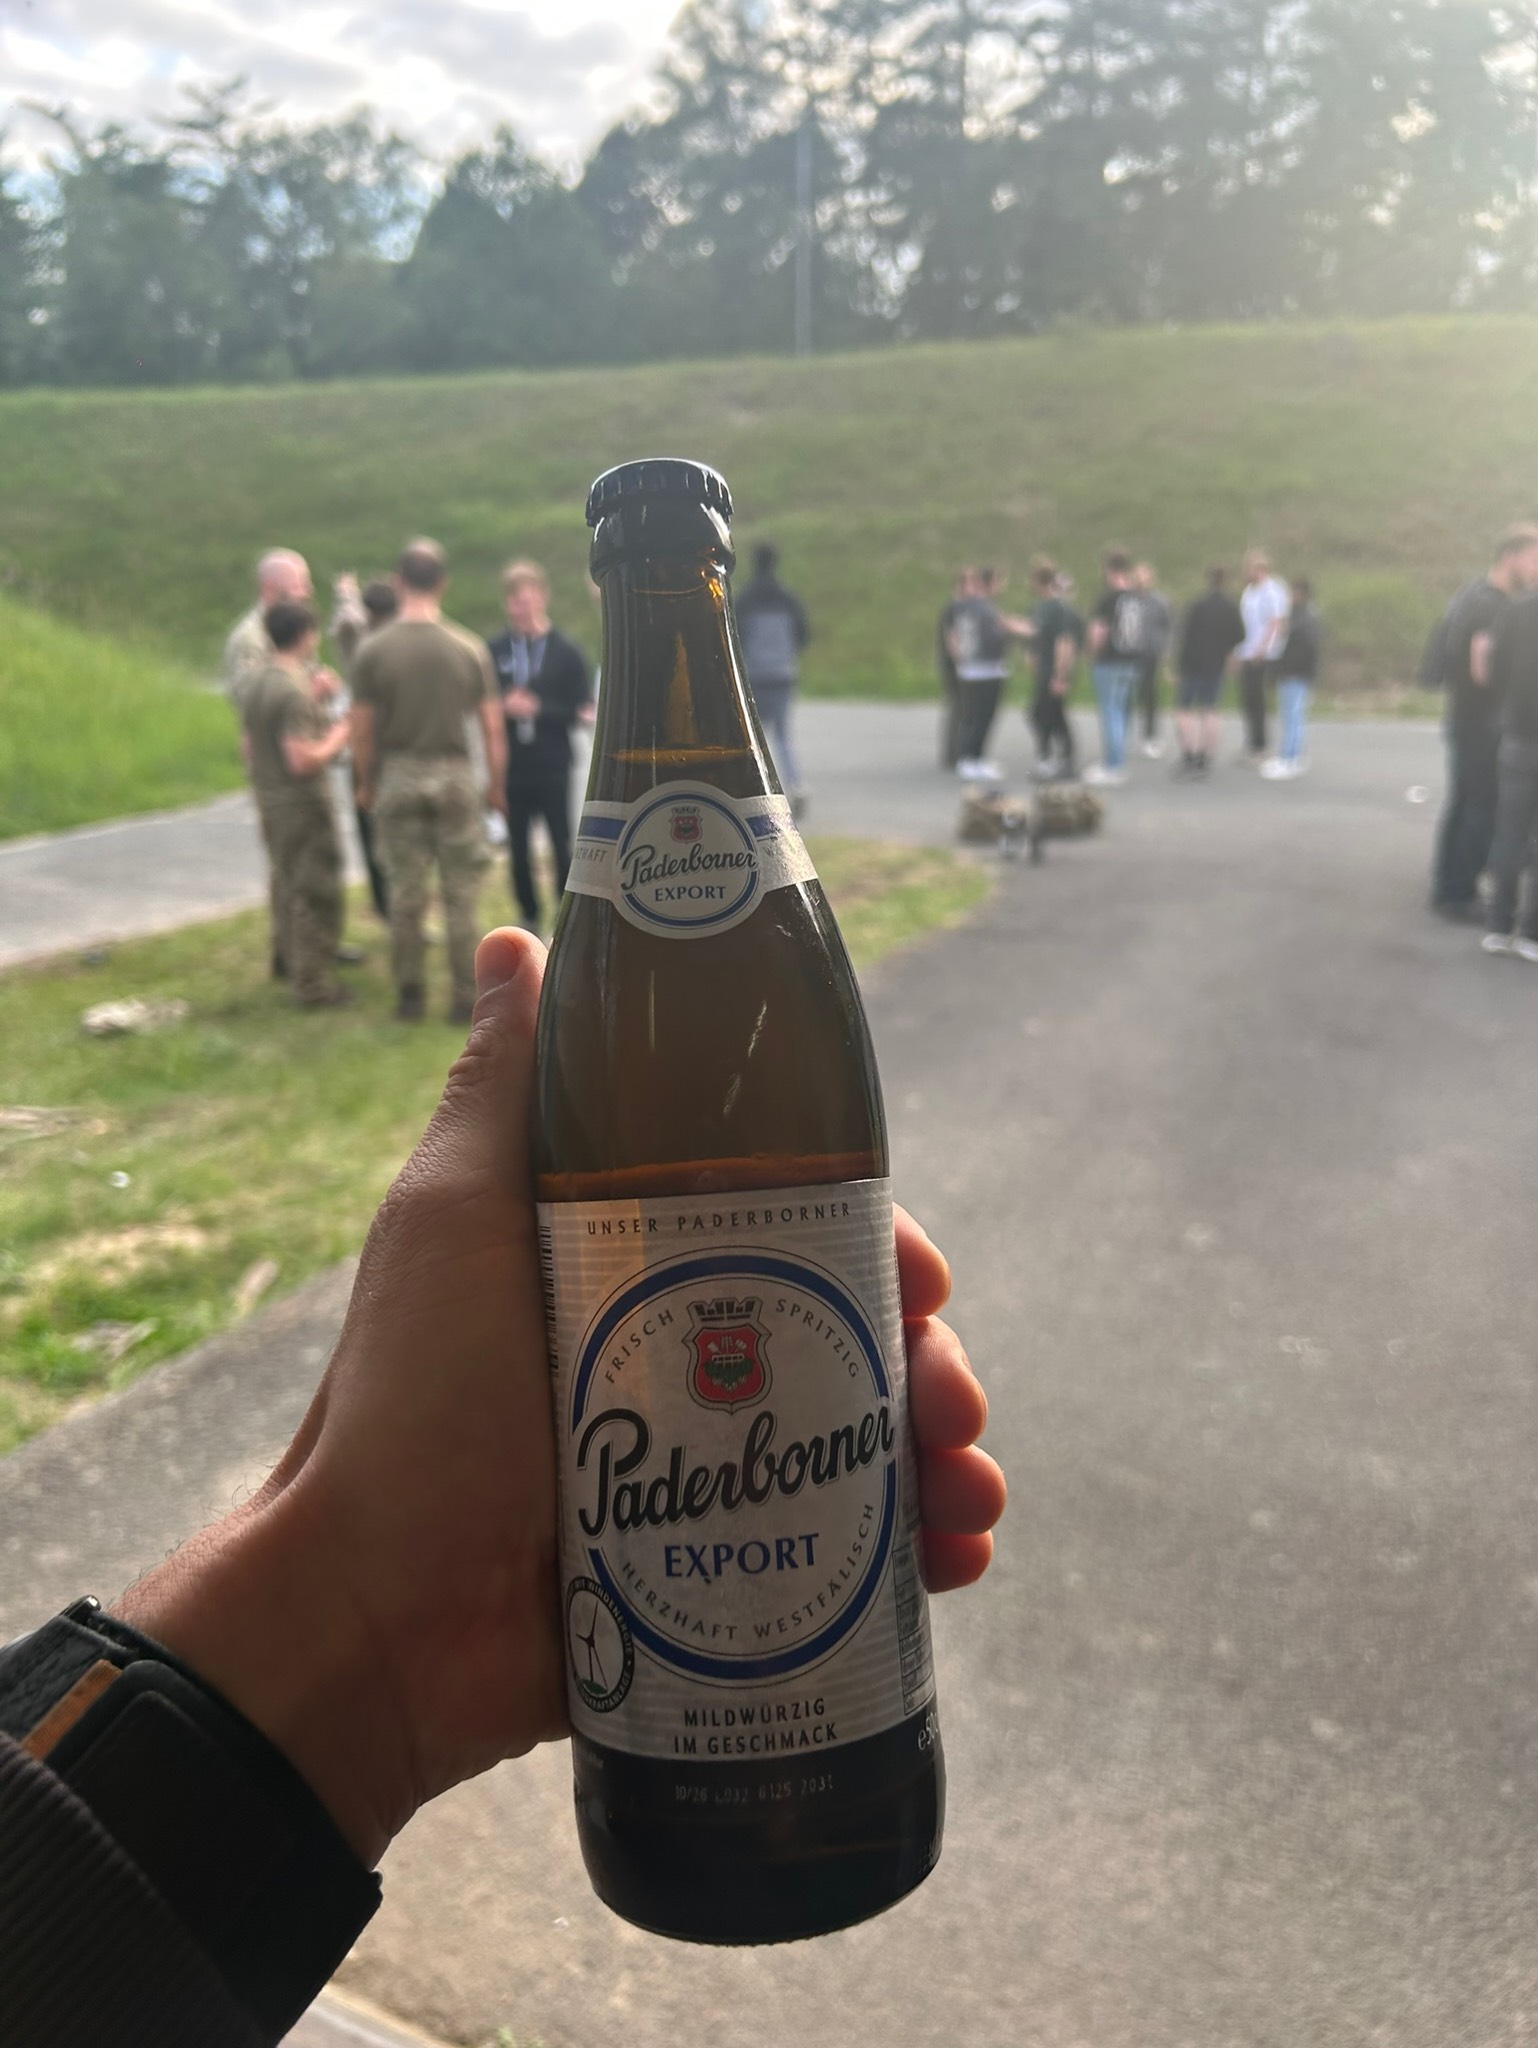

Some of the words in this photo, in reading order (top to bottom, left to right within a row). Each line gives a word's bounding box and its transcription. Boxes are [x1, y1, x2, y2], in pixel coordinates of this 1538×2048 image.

[621, 843, 757, 891] Paderborner
[655, 885, 727, 902] EXPORT
[588, 1217, 659, 1236] UNSER
[678, 1202, 851, 1231] PADERBORNER
[605, 1309, 674, 1384] FRISCH
[776, 1299, 859, 1379] SPRITZIG
[576, 1406, 895, 1537] Paderborner
[622, 1562, 738, 1640] HERZHAFT
[754, 1503, 874, 1640] WESTFÄLISCH
[664, 1533, 819, 1579] EXPORT
[684, 1698, 825, 1727] MILDWÜRZIG
[674, 1736, 697, 1754] IM
[708, 1723, 838, 1754] GESCHMACK
